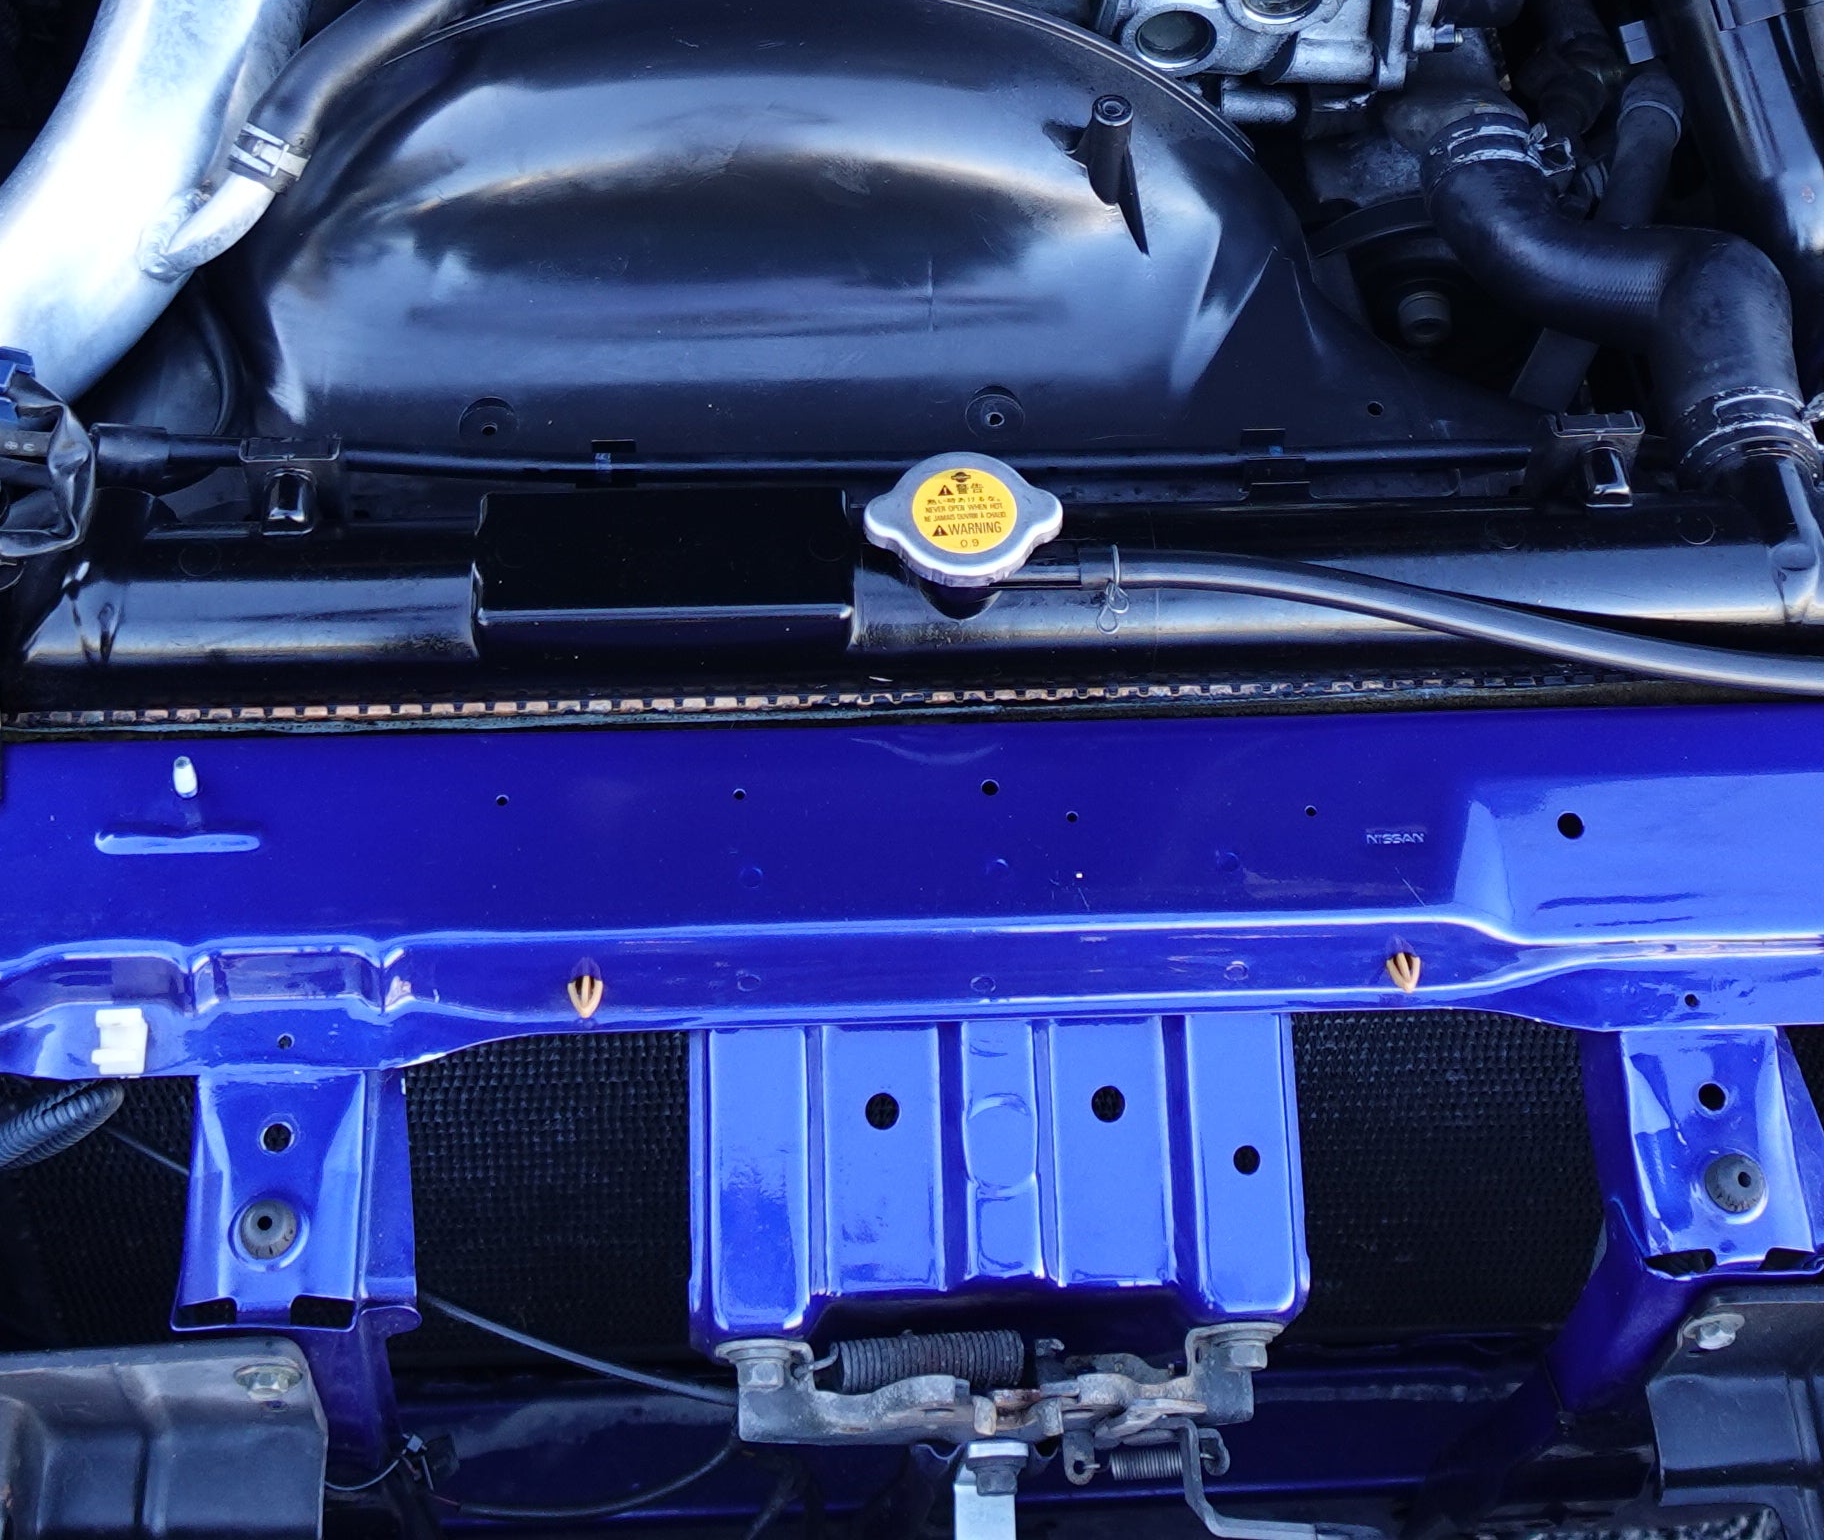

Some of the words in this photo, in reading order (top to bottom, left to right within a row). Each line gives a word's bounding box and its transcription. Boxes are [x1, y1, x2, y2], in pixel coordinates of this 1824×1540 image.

[926, 505, 946, 513] NEVER
[948, 504, 965, 512] OPEN
[968, 503, 987, 511] WHEN
[948, 521, 1002, 536] WARNING
[1366, 832, 1425, 844] NISSAN
